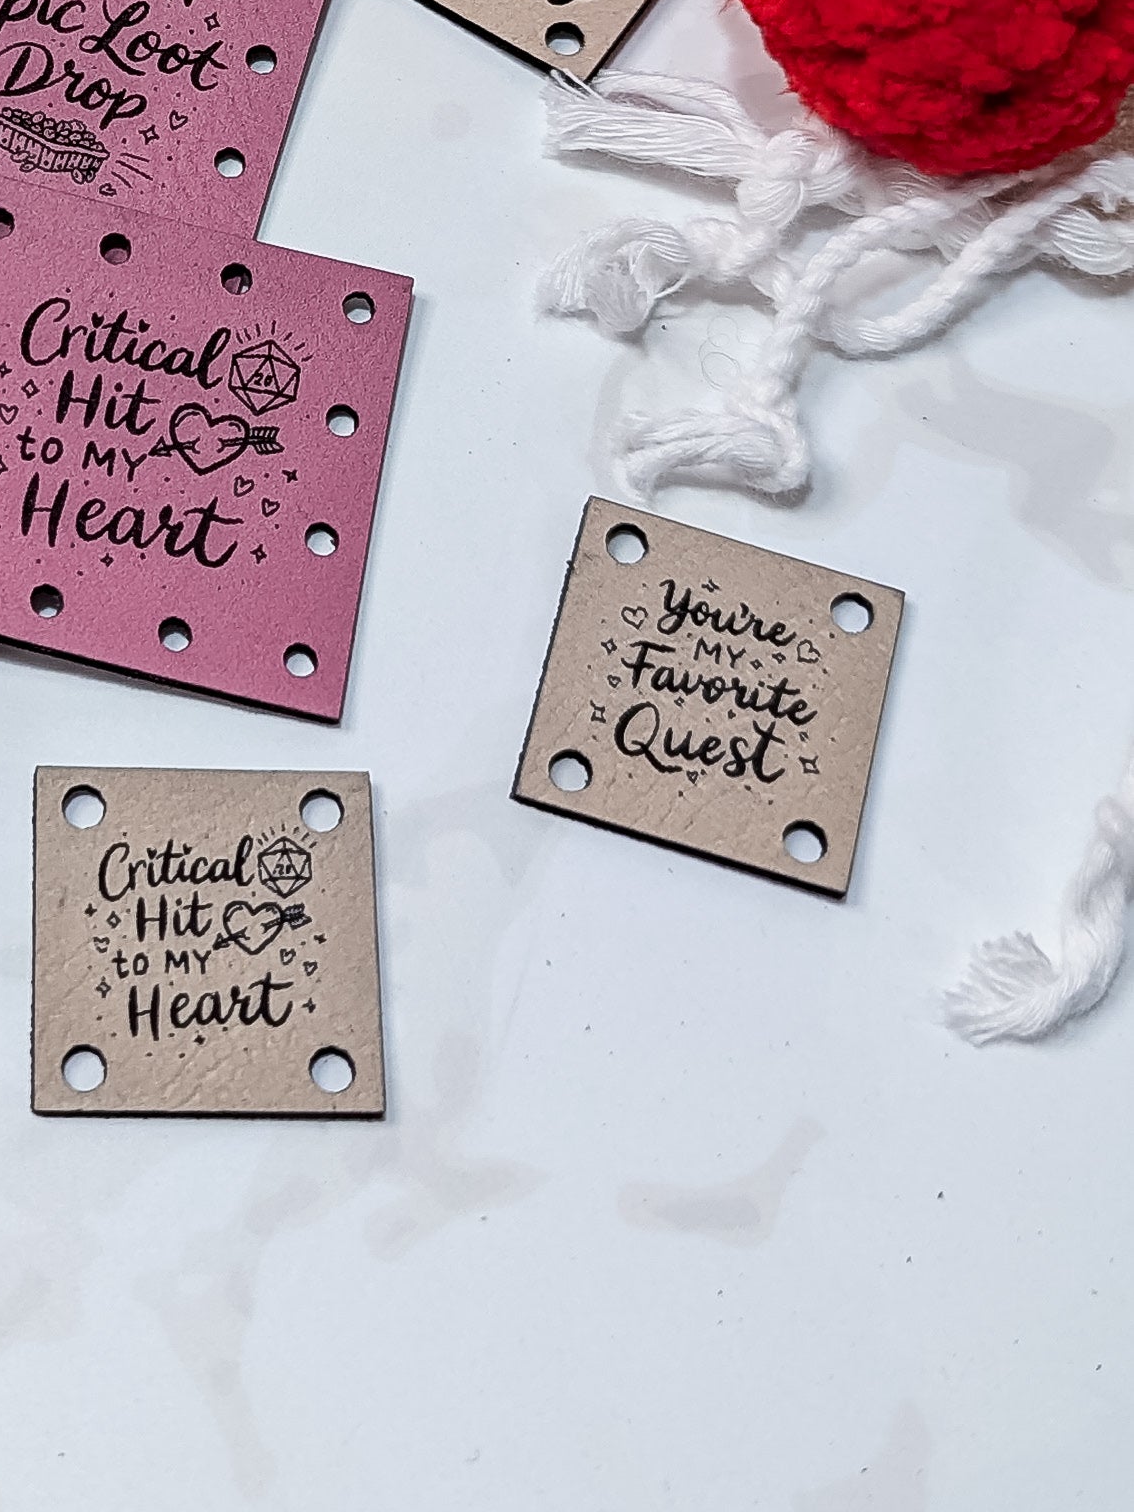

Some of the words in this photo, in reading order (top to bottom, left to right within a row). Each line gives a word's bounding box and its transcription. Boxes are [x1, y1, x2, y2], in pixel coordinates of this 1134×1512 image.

[79, 0, 228, 91] Loot
[20, 297, 231, 389] Critical
[56, 369, 161, 435] Hit
[82, 440, 147, 482] MY
[21, 471, 244, 568] Heart
[656, 579, 797, 647] You're
[620, 640, 817, 726] Favorite
[694, 637, 746, 669] MY
[614, 701, 786, 783] Quest
[98, 835, 254, 902] Critical
[136, 891, 213, 942] Hit
[165, 949, 212, 975] MY
[128, 971, 294, 1041] Heart
